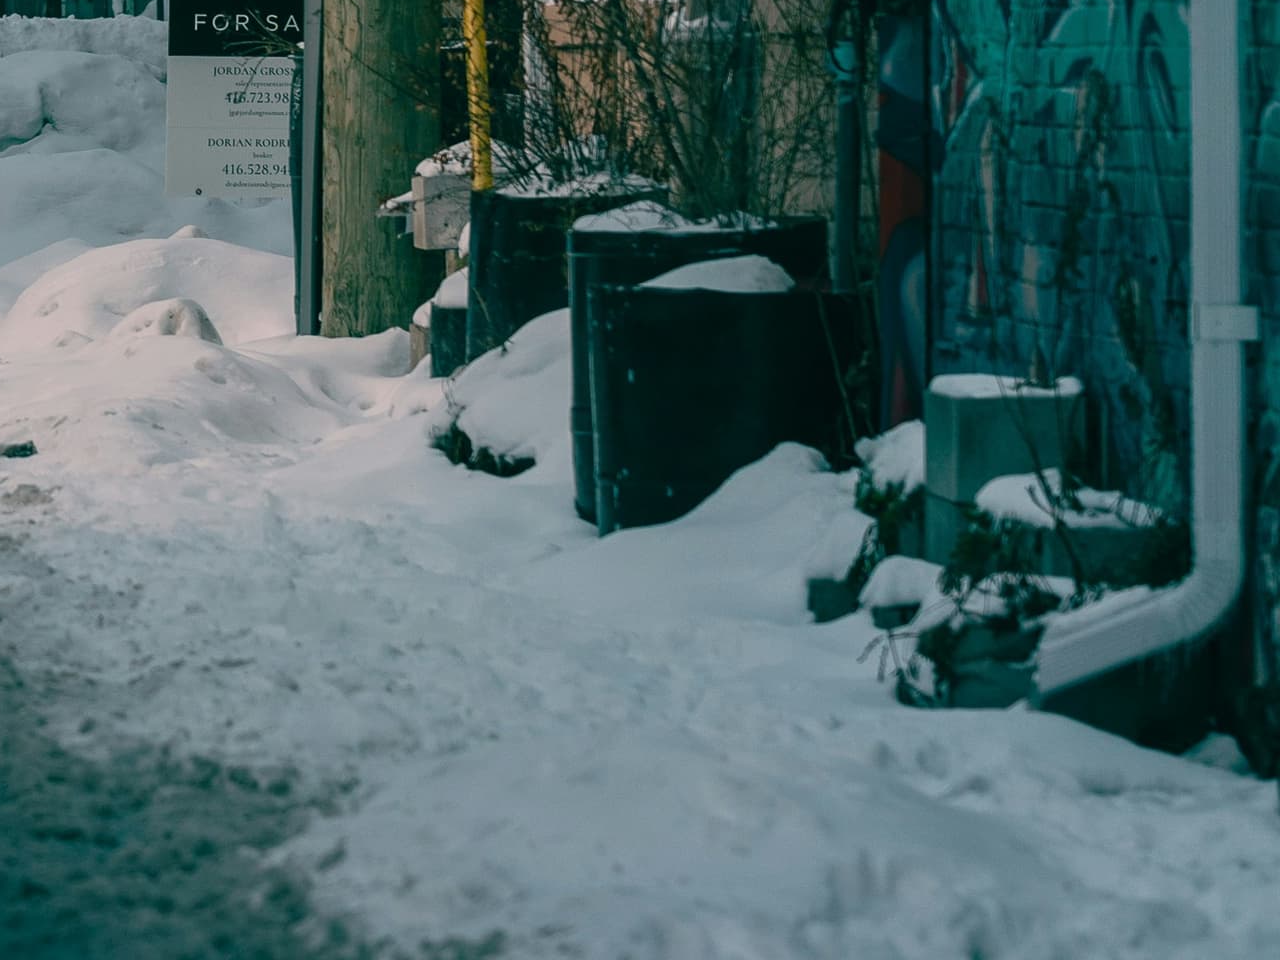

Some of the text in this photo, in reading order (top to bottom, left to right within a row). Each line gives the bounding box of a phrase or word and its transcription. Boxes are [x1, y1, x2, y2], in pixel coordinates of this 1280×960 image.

[193, 13, 301, 32] FOR SA
[213, 66, 257, 77] JORDAN
[207, 138, 252, 148] DORIAN
